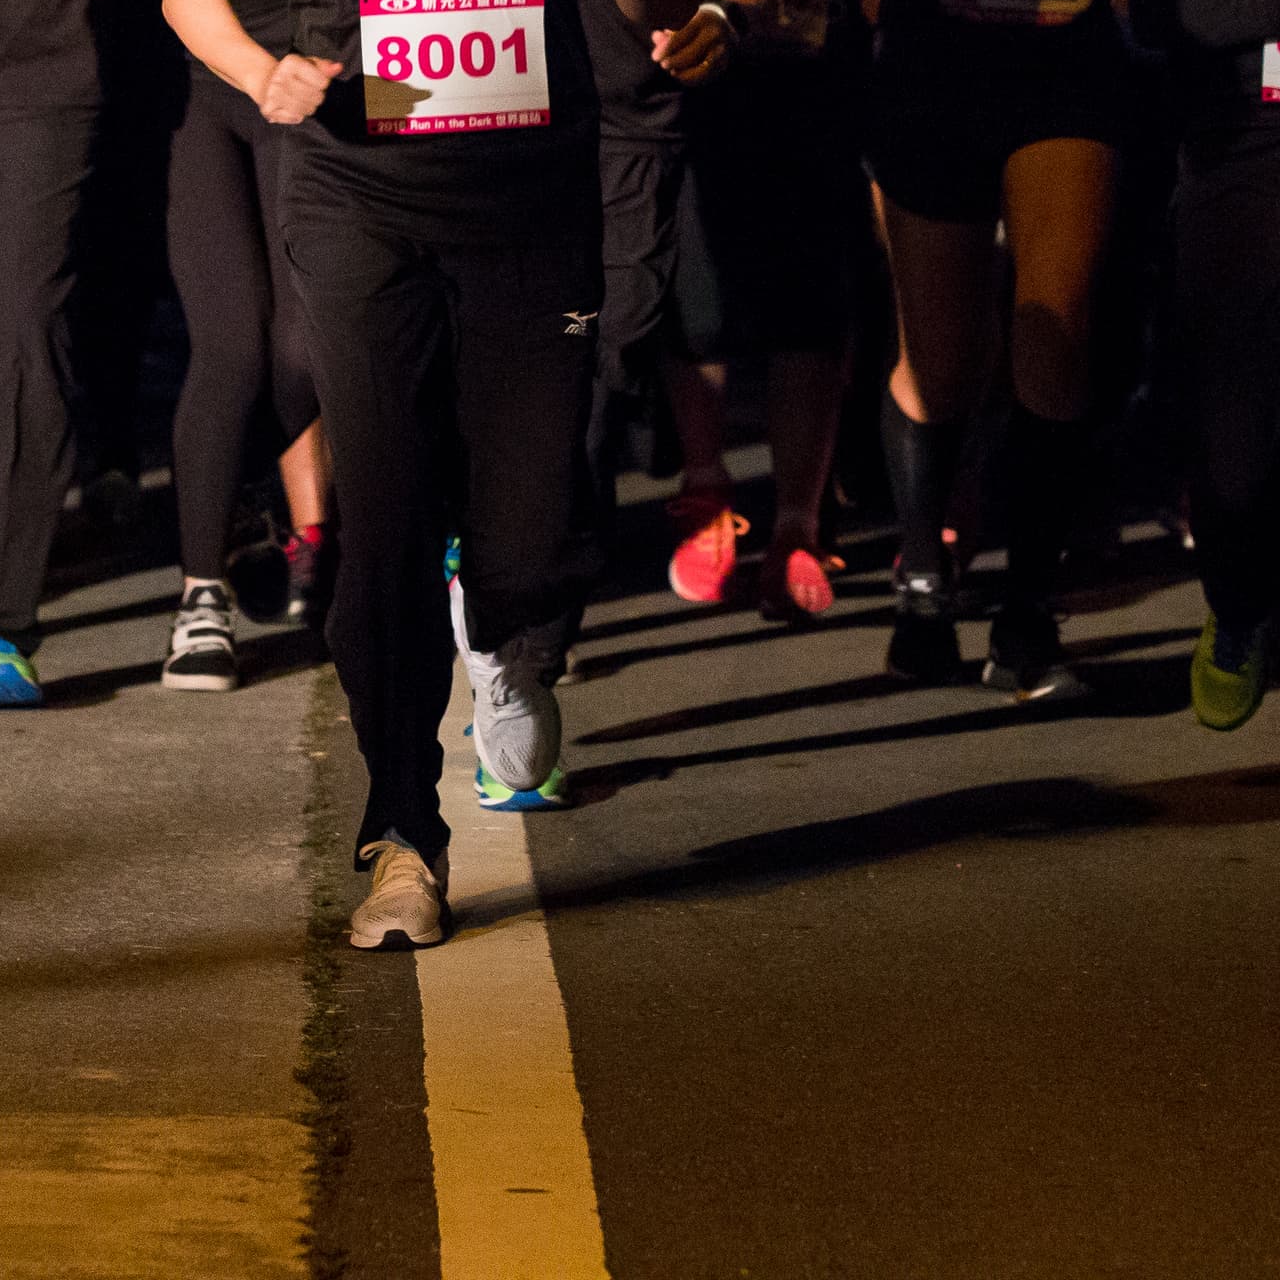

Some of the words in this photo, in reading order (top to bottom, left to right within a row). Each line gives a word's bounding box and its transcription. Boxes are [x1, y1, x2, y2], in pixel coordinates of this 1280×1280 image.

[376, 27, 528, 81] 8001
[410, 118, 432, 131] Run
[434, 118, 445, 129] in
[448, 117, 465, 128] the
[469, 115, 492, 127] Dark
